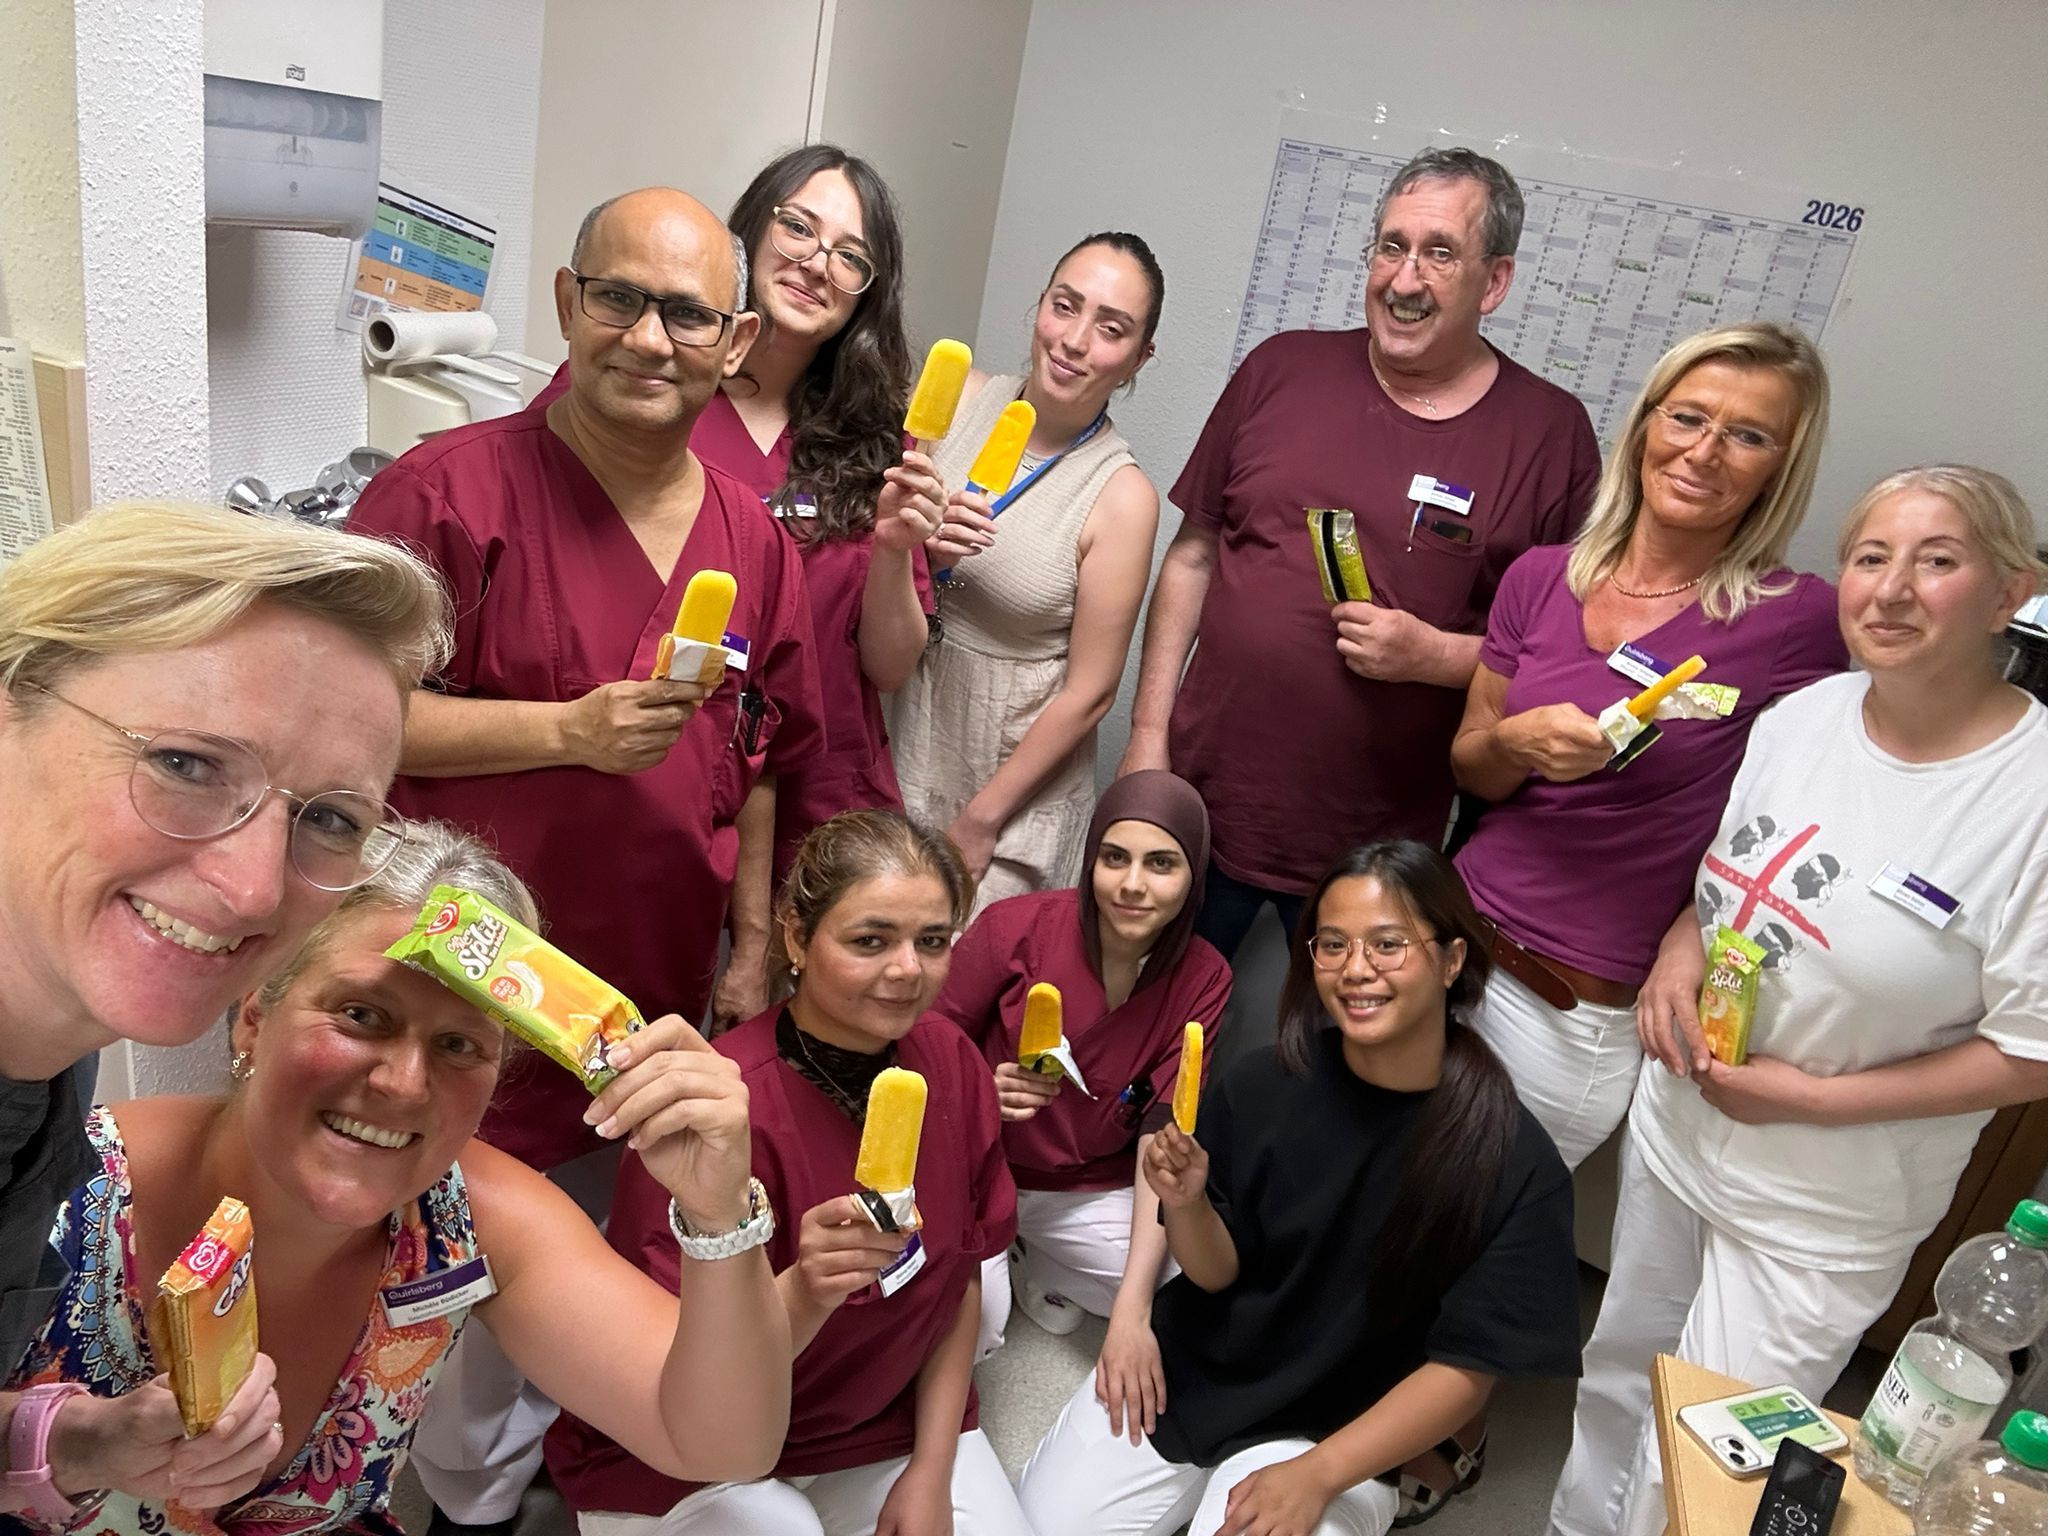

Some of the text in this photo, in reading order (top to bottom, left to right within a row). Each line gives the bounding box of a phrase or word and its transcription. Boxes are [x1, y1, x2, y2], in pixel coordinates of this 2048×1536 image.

[1802, 199, 1865, 233] 2026
[458, 913, 502, 981] Split
[1709, 967, 1743, 990] Split
[213, 1238, 254, 1317] CAP
[388, 1281, 444, 1300] Quirlsberg
